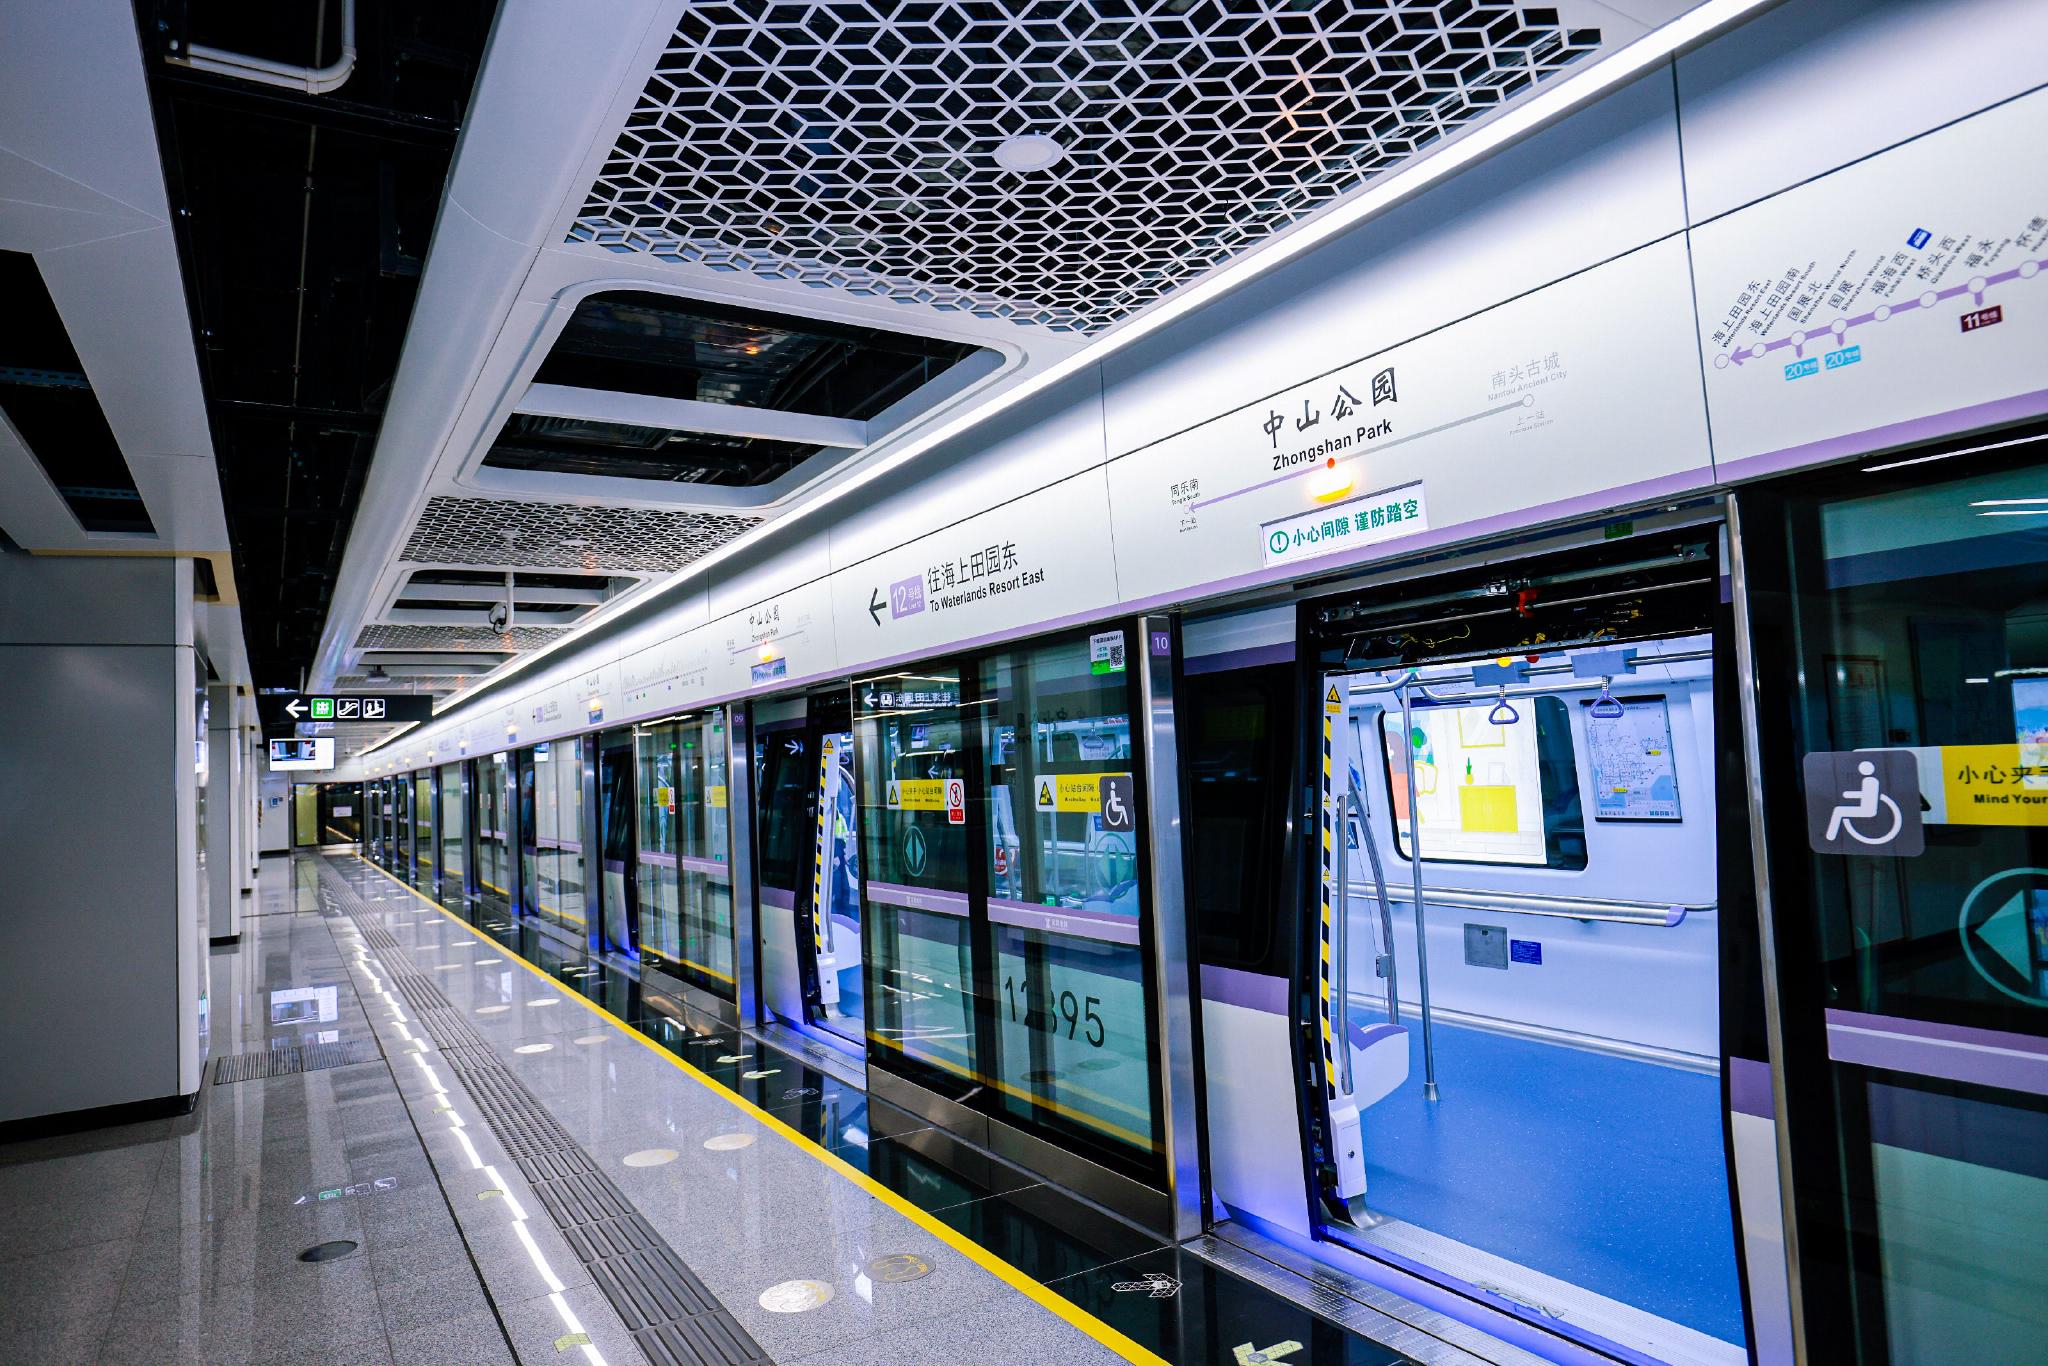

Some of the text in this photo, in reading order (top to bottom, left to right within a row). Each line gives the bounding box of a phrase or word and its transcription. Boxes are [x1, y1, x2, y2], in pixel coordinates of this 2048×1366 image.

[1870, 251, 1908, 295] 福海西
[1916, 235, 1956, 280] 桥头西
[1712, 280, 1760, 344] 海上田园东
[1748, 267, 1800, 334] 海上田园南
[1787, 281, 1822, 322] 国展北
[1827, 280, 1855, 309] 国展
[1492, 351, 1560, 390] 南头古城
[1517, 376, 1549, 393] Ancient
[1550, 370, 1568, 382] City
[1262, 366, 1398, 449] 中山公园
[1272, 418, 1393, 472] Zhongshan Park
[1292, 498, 1420, 548] 小心间隙 谨防踏空
[927, 540, 1018, 595] 往海上田园东
[930, 568, 1045, 613] To Waterlands Resort East
[1154, 636, 1168, 650] 10
[734, 715, 744, 723] 09
[1974, 794, 2009, 803] Mind
